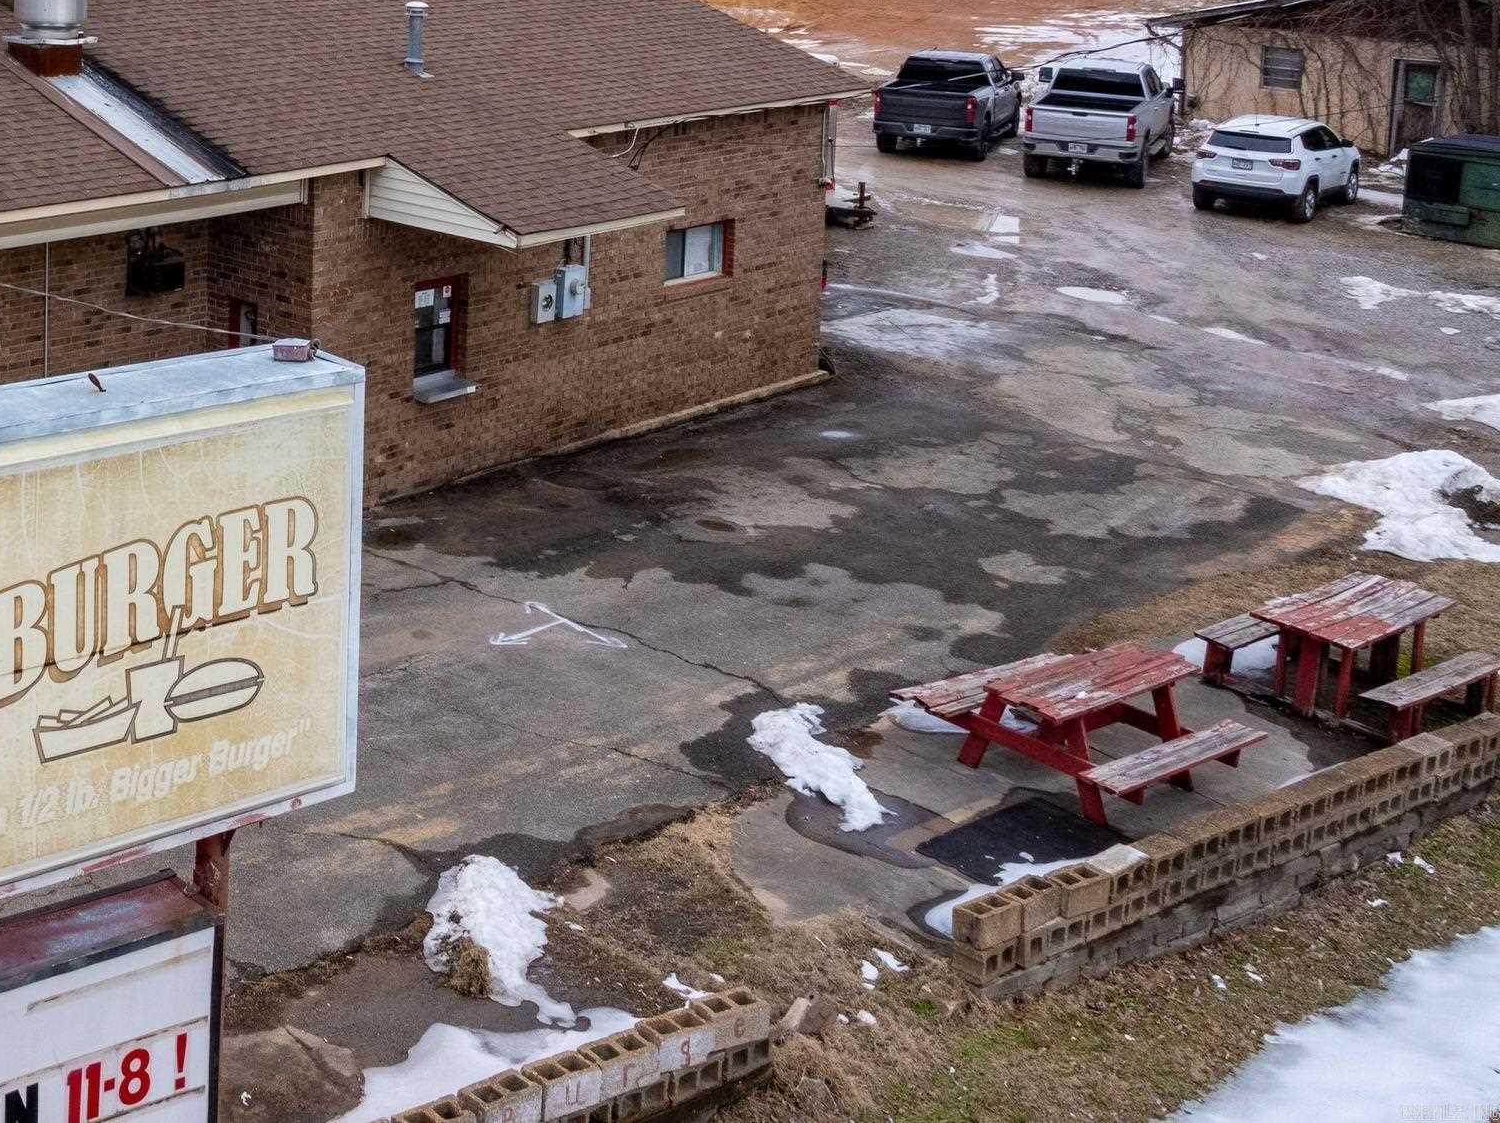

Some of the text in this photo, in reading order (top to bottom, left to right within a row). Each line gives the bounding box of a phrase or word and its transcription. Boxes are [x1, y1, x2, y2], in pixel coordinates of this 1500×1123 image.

[17, 787, 61, 828] 1/2
[109, 752, 201, 804] Bigger
[67, 1048, 151, 1123] 11-8
[174, 1032, 187, 1090] !
